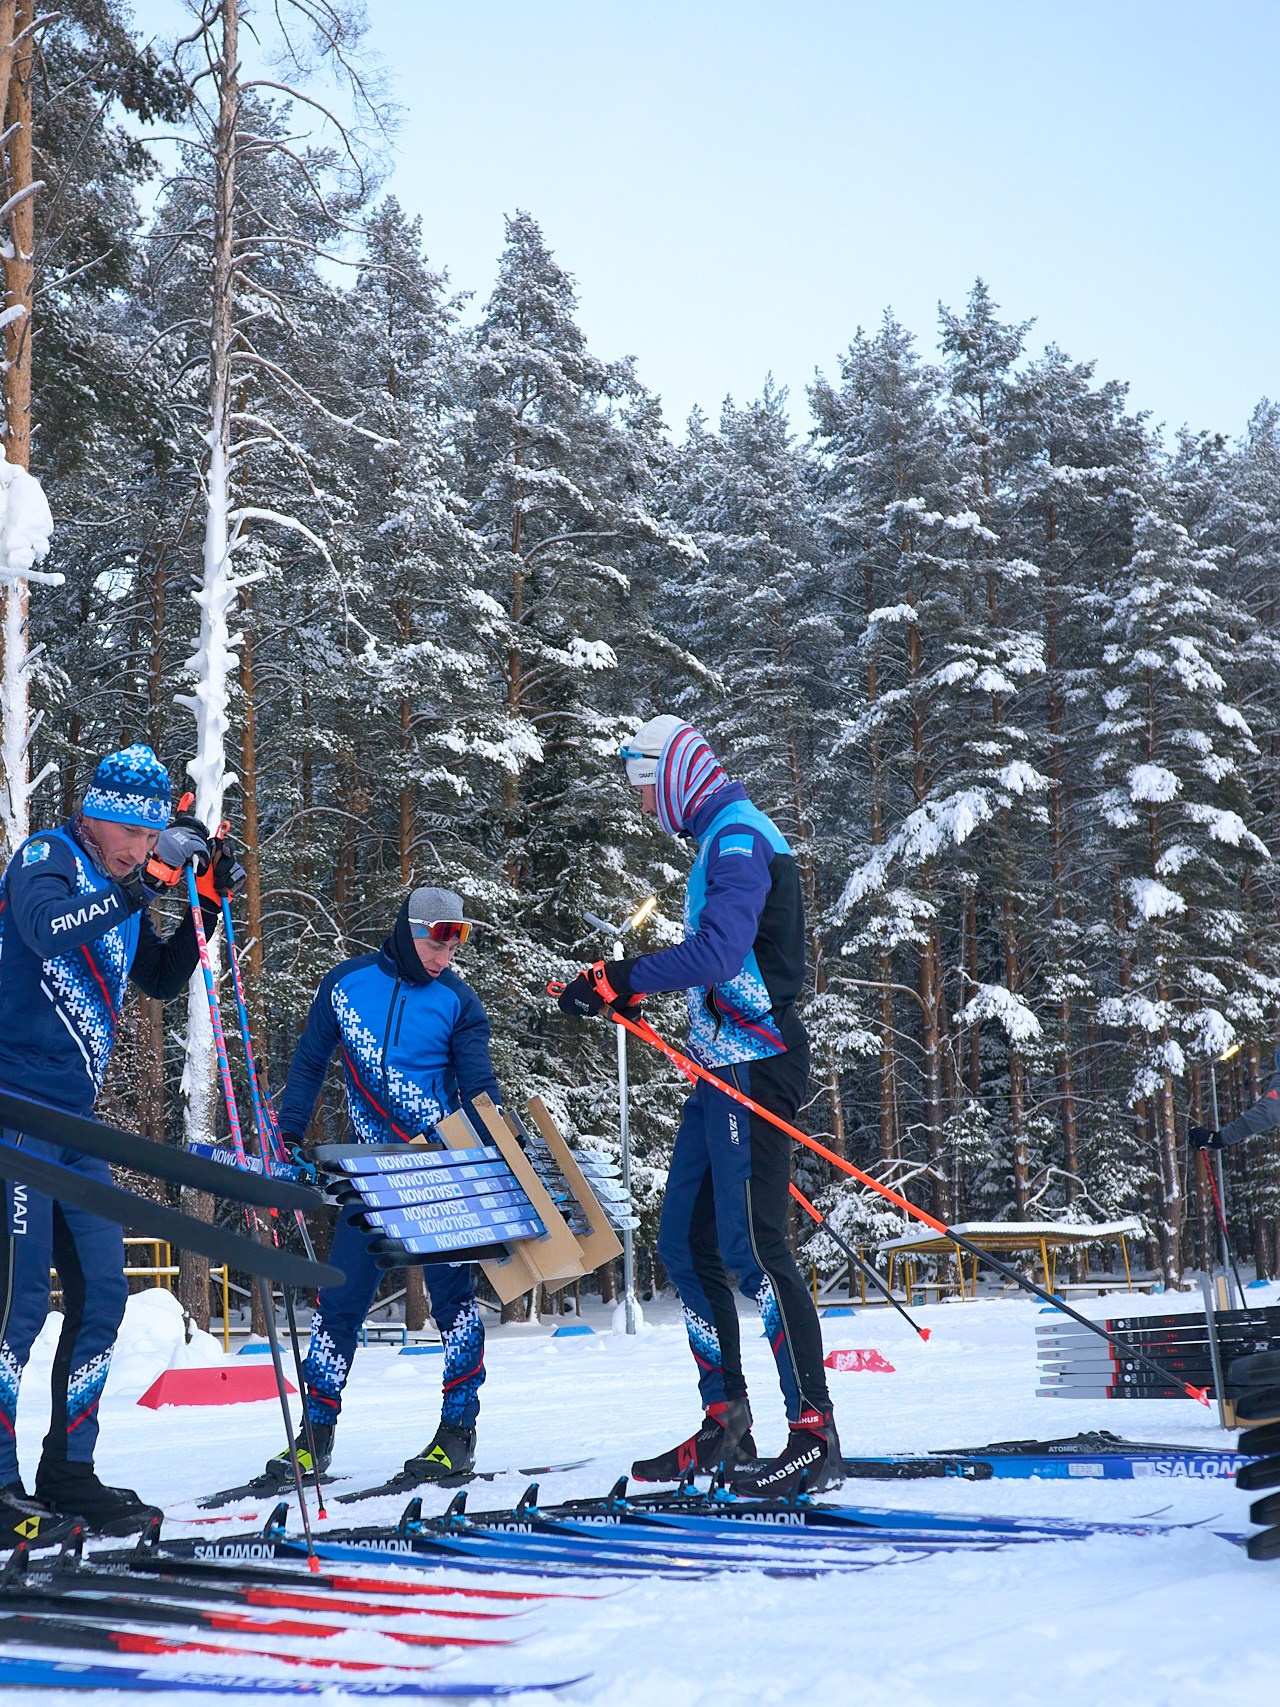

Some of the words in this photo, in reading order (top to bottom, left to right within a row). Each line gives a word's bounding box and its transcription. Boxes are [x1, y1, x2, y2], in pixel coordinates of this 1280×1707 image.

[50, 894, 119, 935] ЯМАЛ
[210, 1148, 253, 1170] SOMON
[376, 1152, 431, 1170] SALOMON
[387, 1170, 440, 1188] SALOMON
[398, 1185, 454, 1203] SALOMON
[13, 1181, 28, 1235] МАЛ
[403, 1201, 459, 1221] SALOMON
[419, 1215, 472, 1235] SALOMON
[435, 1229, 486, 1249] SALOMON
[1048, 1445, 1078, 1453] ATOMIC
[756, 1446, 822, 1488] MADSHUS
[1156, 1461, 1252, 1478] SALOM
[707, 1513, 806, 1526] OMON
[193, 1544, 275, 1560] SALOMON
[337, 1539, 413, 1553] OMON
[28, 1572, 53, 1583] OMIC
